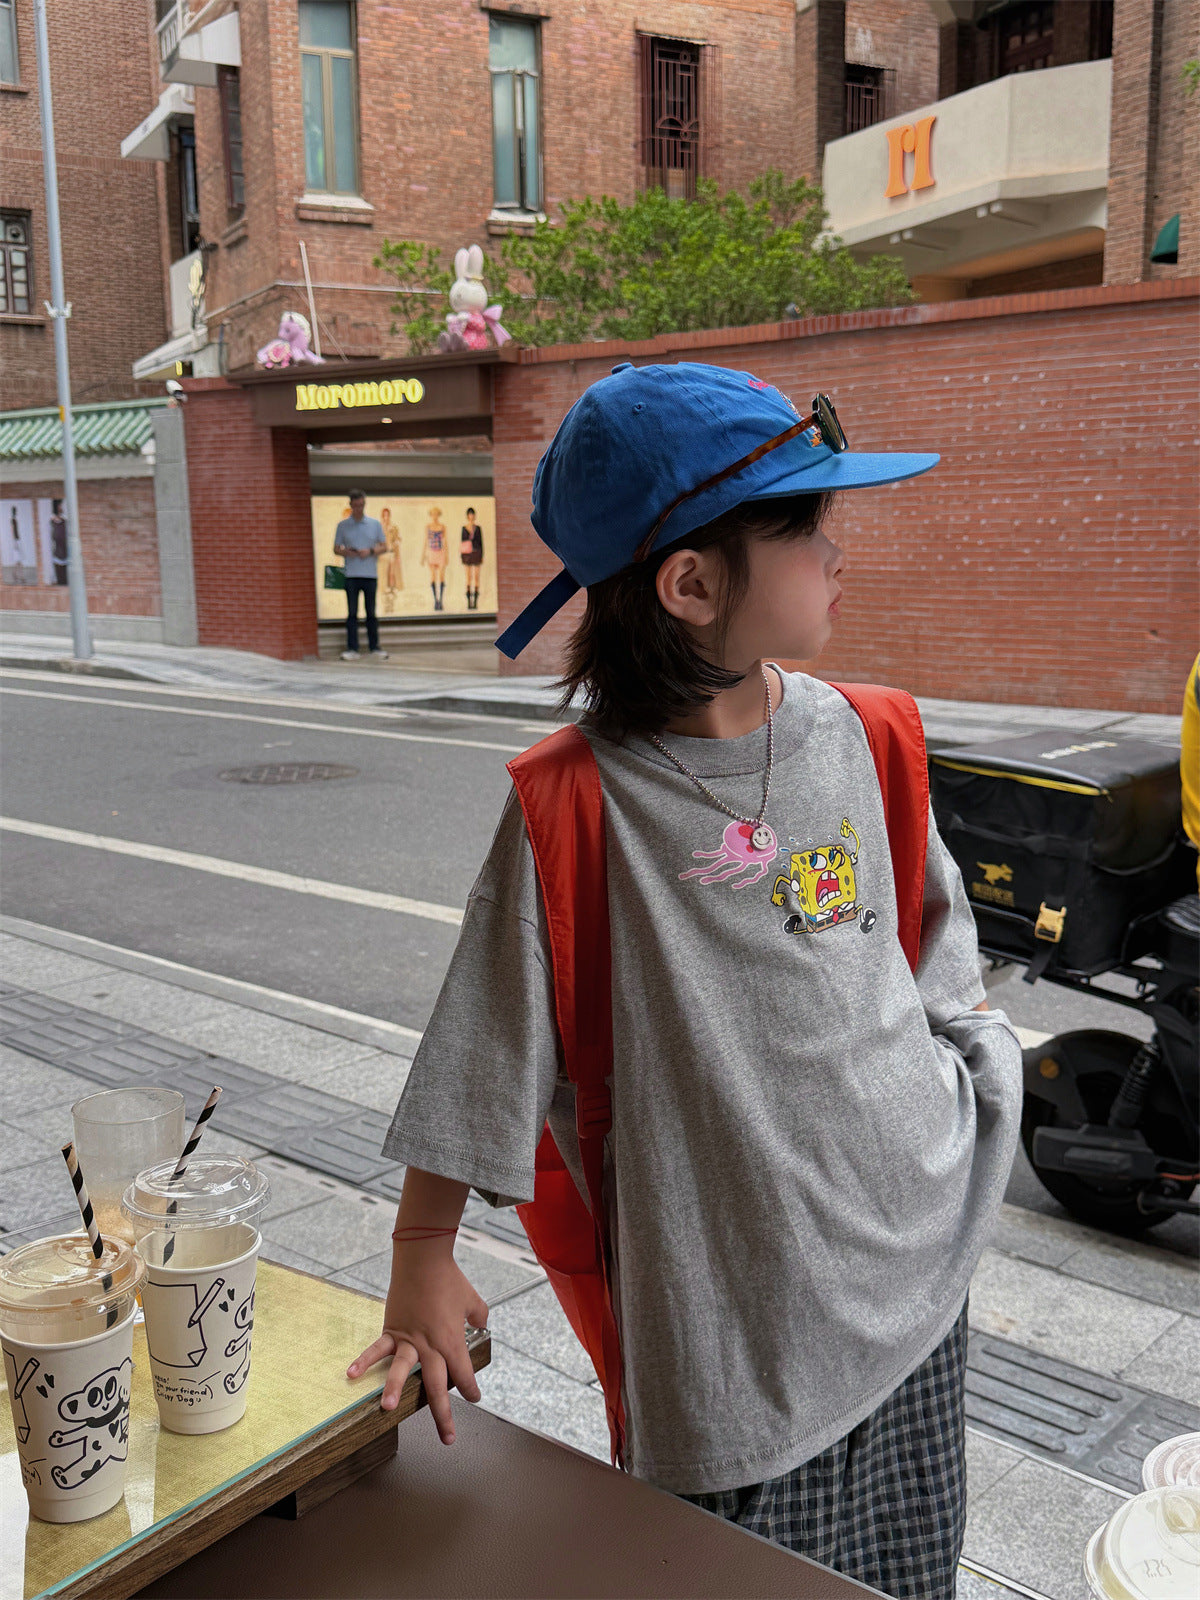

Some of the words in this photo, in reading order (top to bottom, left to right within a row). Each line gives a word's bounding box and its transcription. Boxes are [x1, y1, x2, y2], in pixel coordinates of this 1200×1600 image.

[295, 378, 424, 411] Moromoro
[180, 1387, 207, 1396] friend
[176, 1394, 194, 1407] Dog
